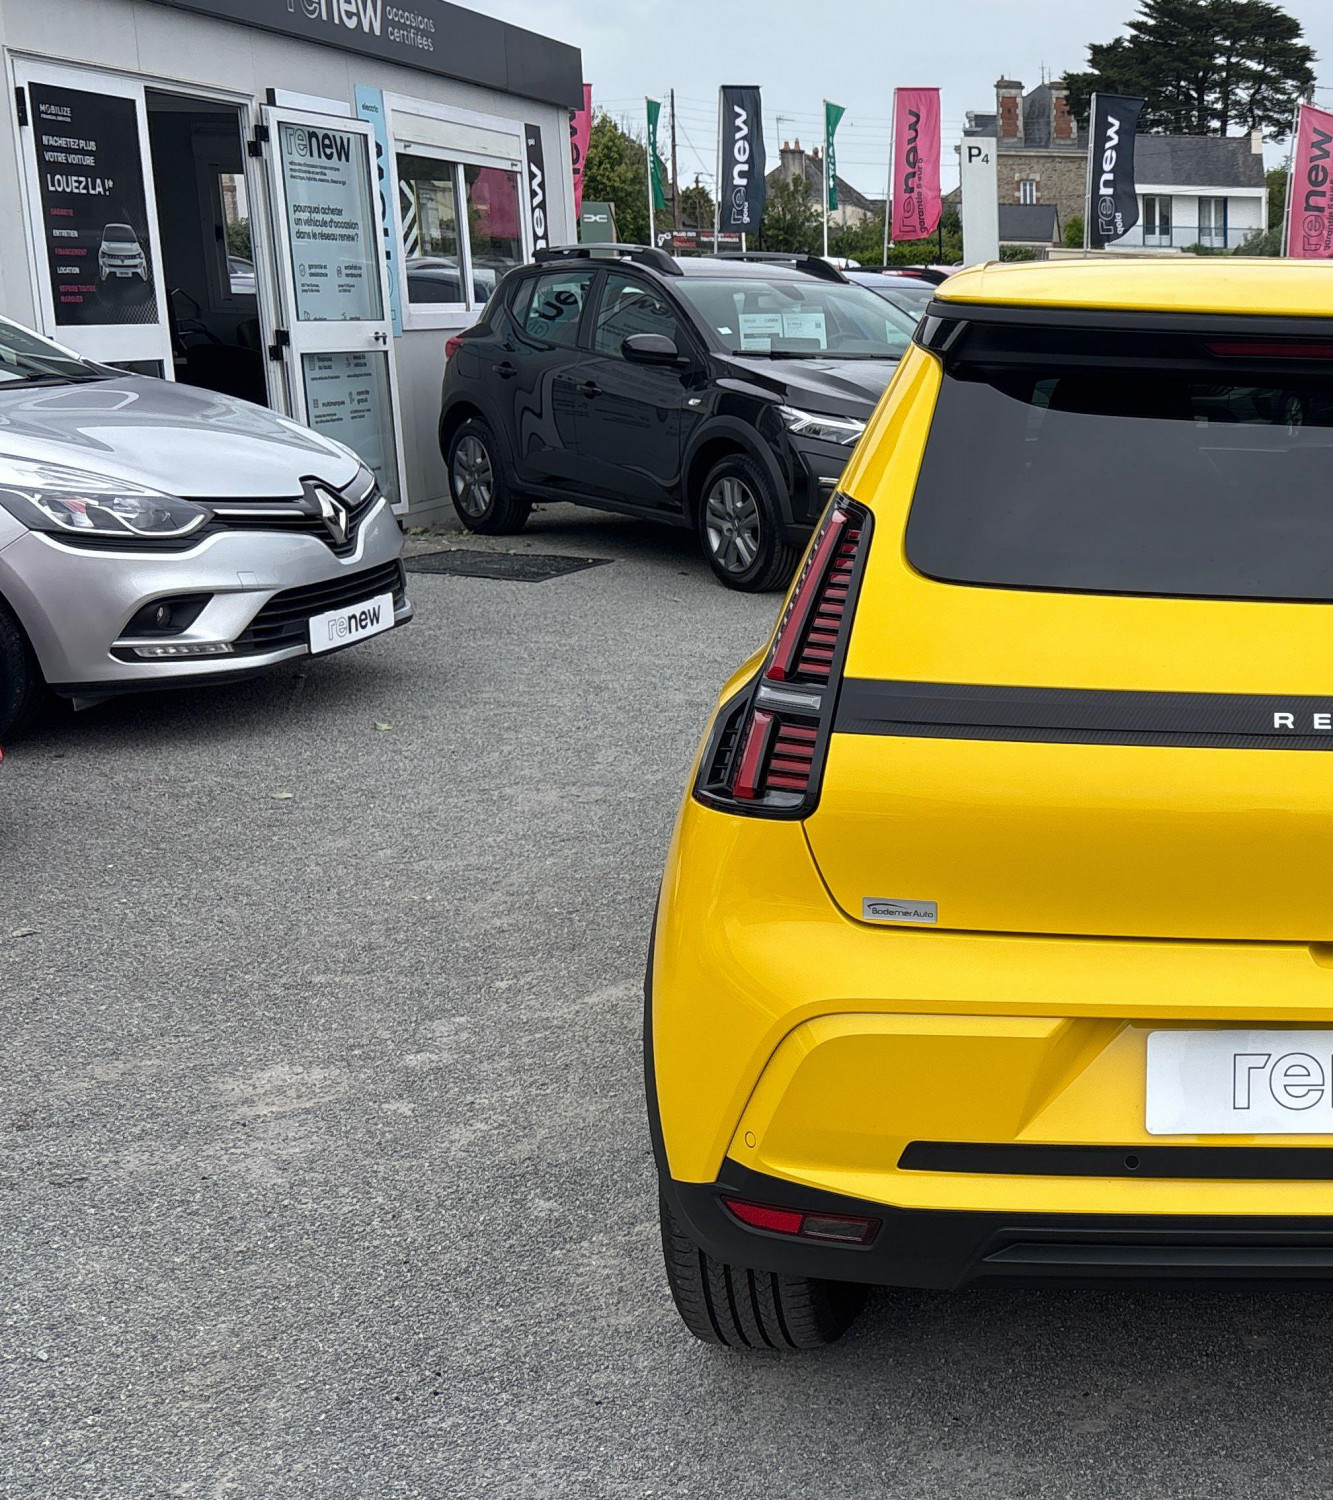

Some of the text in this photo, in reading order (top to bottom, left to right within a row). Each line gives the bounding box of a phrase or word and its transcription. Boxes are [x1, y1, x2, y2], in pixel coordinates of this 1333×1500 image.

[386, 6, 435, 32] occasions
[387, 26, 434, 51] certifiées
[80, 140, 96, 151] PLUS
[285, 127, 350, 163] renew
[967, 146, 990, 164] P4
[44, 151, 95, 166] VOTRE VOITURE
[731, 105, 750, 224] renew
[899, 109, 920, 233] renew
[47, 174, 87, 194] LOUEZ
[88, 178, 104, 195] LA
[1098, 115, 1120, 235] renew
[1303, 127, 1333, 252] renew
[1114, 212, 1124, 234] gold
[328, 605, 381, 641] renew
[871, 907, 934, 918] BodemerAuto
